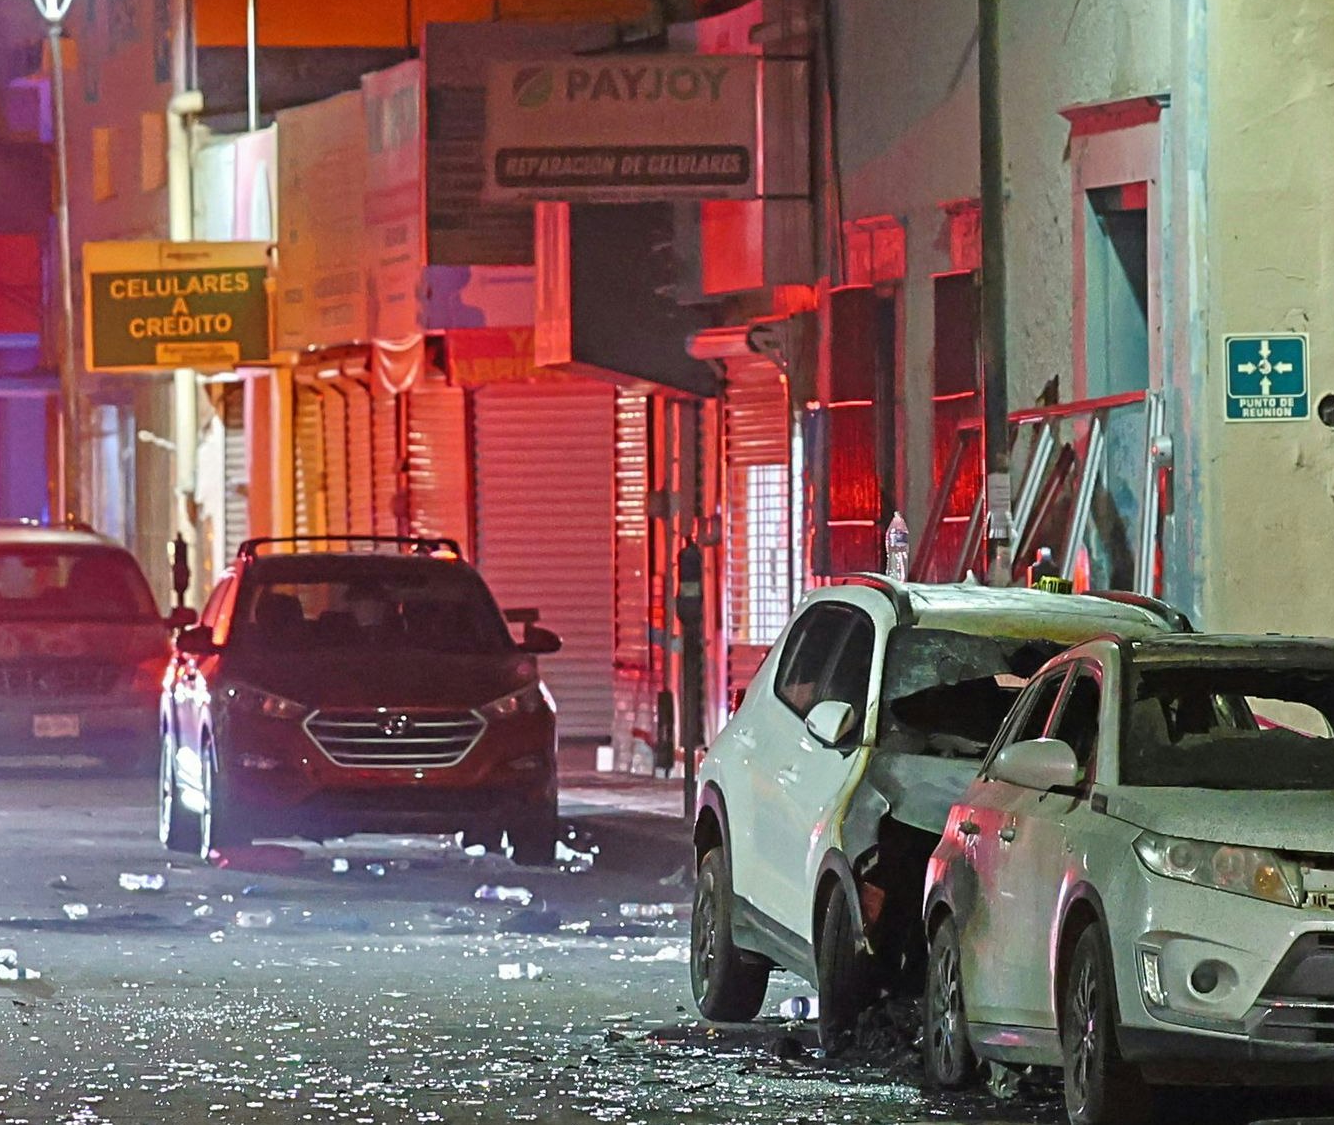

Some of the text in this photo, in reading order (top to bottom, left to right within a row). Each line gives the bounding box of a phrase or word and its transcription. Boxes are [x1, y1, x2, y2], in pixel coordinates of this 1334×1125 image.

[566, 66, 729, 102] PAYJOY
[620, 155, 644, 175] DE
[110, 272, 249, 299] CELULARES
[172, 297, 189, 316] A
[129, 313, 233, 338] CREDITO
[1239, 398, 1294, 408] PUNTO DE
[1242, 407, 1292, 417] REUNION
